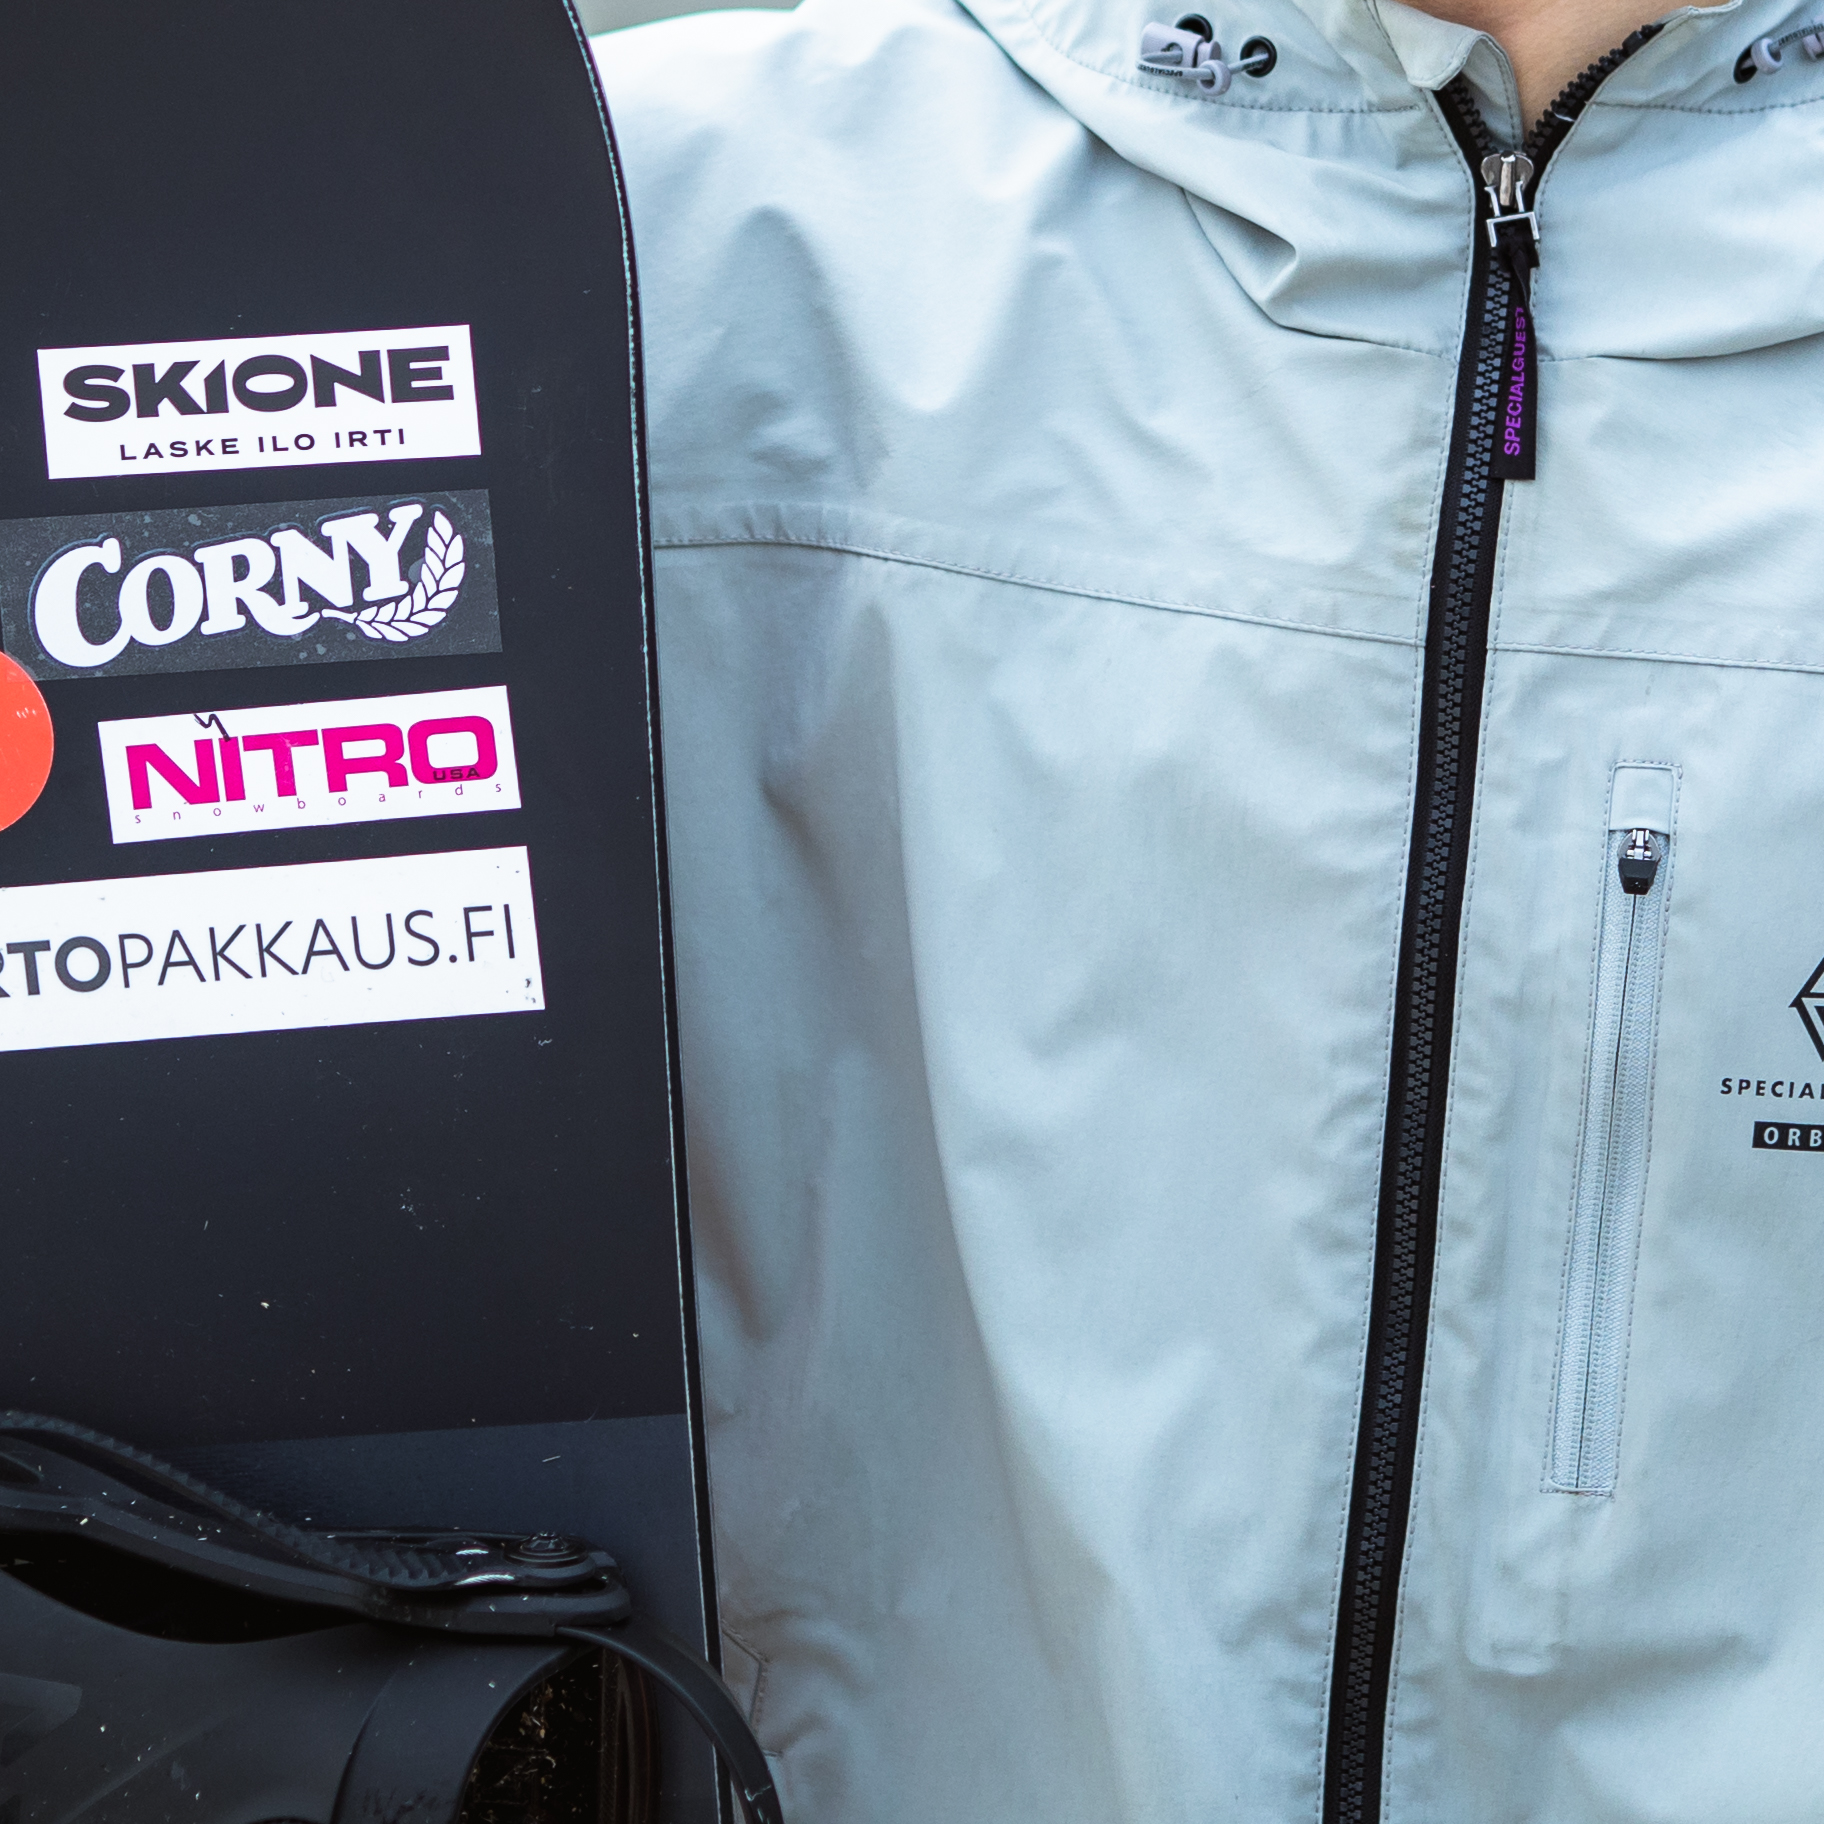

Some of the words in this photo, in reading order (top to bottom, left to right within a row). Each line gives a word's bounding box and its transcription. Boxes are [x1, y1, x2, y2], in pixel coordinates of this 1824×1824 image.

[63, 345, 455, 423] SKIONE
[1503, 307, 1527, 457] SPECIALGUEST
[119, 437, 241, 461] LASKE
[258, 433, 316, 453] ILO
[334, 428, 407, 449] IRTI
[34, 503, 423, 668] CORNY
[125, 715, 498, 810] NITRO
[432, 767, 481, 782] USA
[134, 783, 503, 824] snowboards
